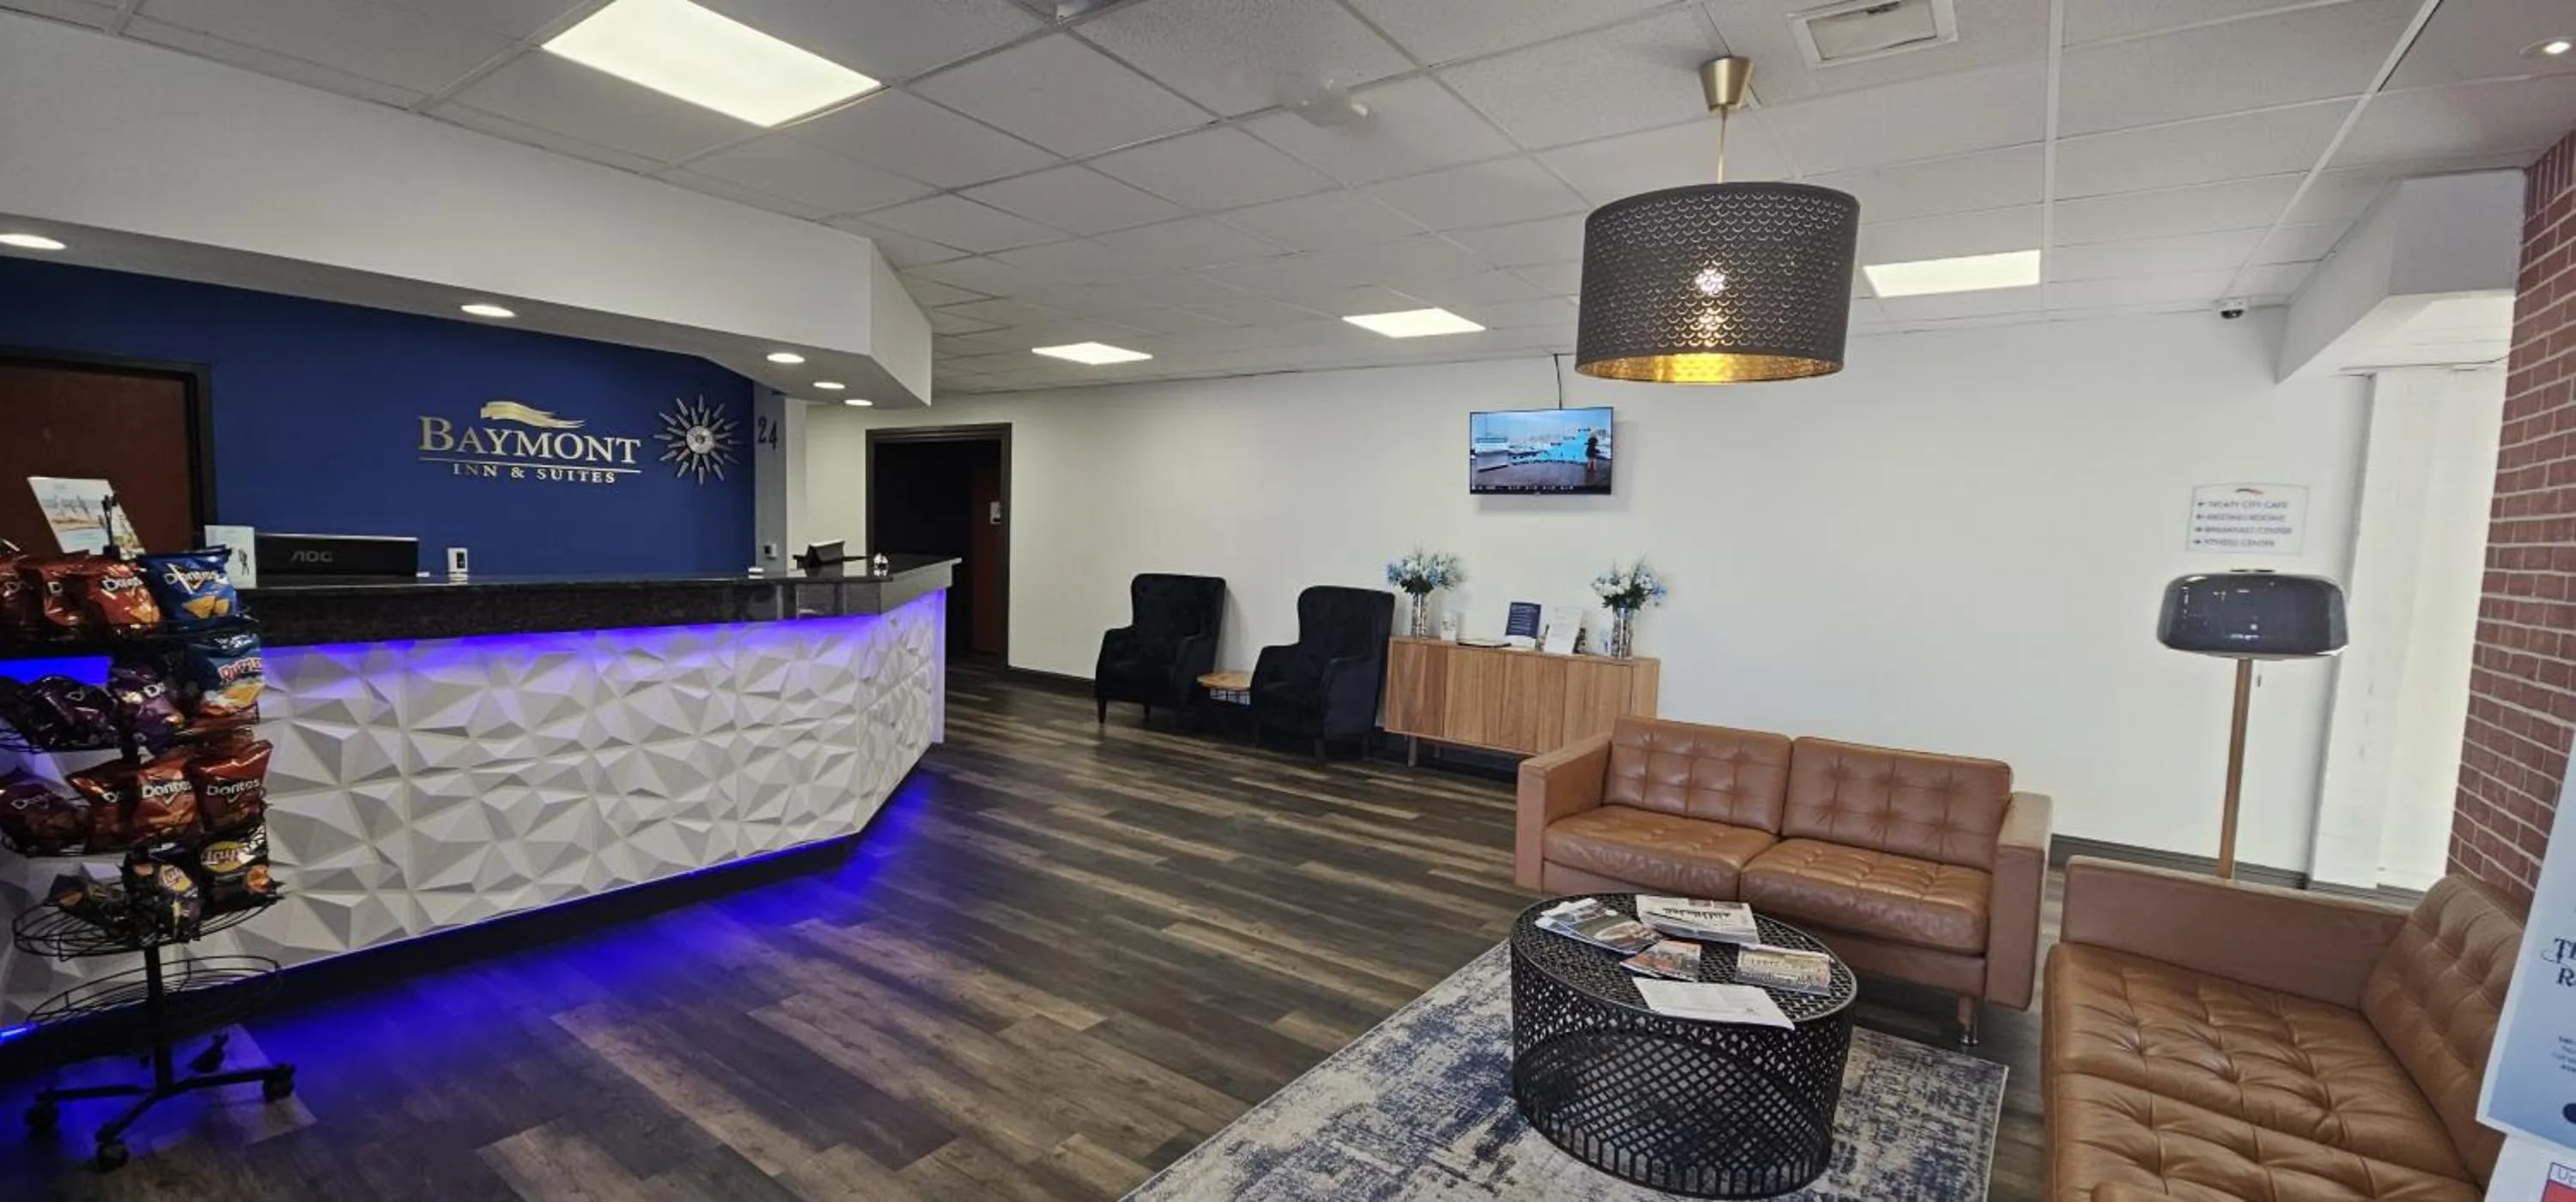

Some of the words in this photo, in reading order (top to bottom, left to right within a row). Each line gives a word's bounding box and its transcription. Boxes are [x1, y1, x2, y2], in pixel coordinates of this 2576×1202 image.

[418, 416, 642, 464] BAYMONT
[757, 416, 777, 451] 24
[453, 463, 498, 477] INN
[511, 466, 525, 478] &
[536, 468, 616, 483] SUITES
[142, 780, 191, 798] Doritos
[206, 779, 259, 796] Doritos
